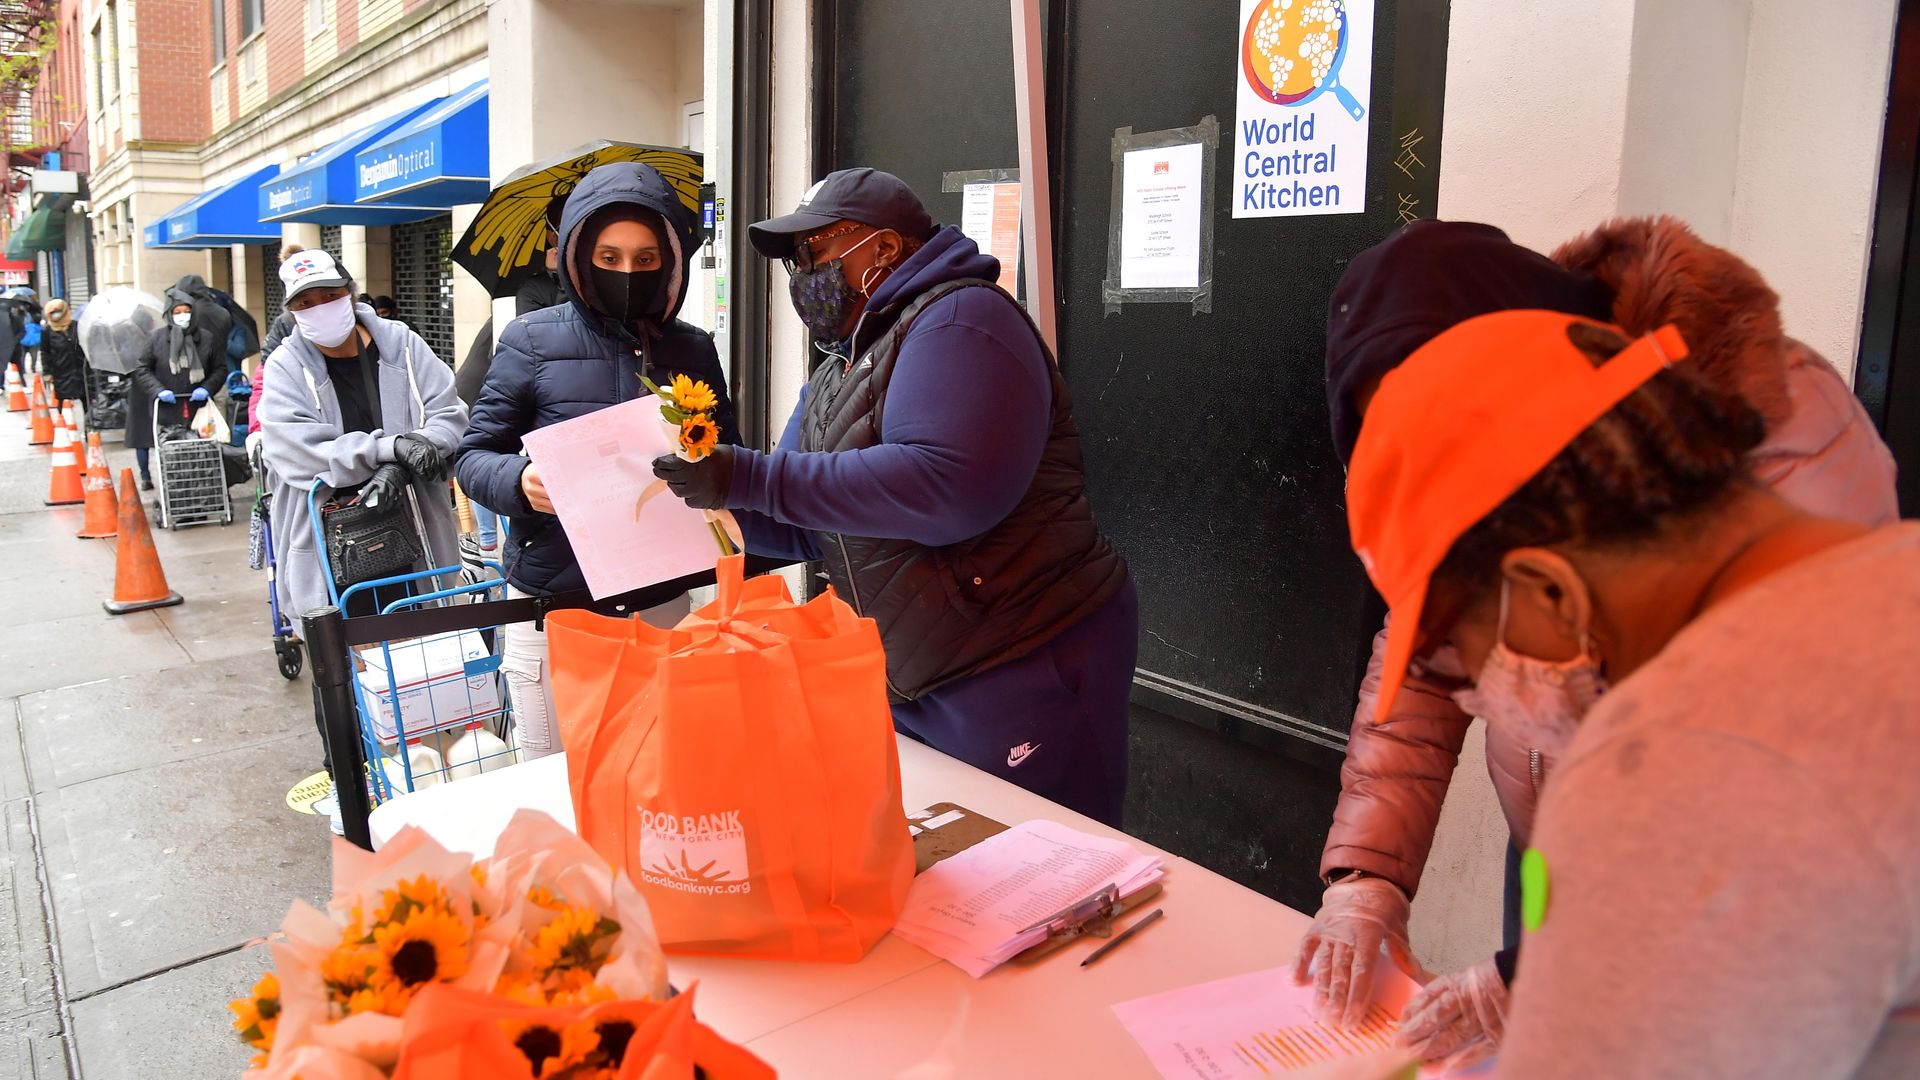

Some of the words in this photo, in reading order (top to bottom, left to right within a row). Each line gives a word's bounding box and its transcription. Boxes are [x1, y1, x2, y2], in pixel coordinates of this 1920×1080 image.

[1242, 112, 1315, 147] World
[360, 153, 398, 190] Benjamin
[398, 141, 435, 180] Optical
[1244, 143, 1336, 179] Central
[1243, 180, 1340, 211] Kitchen
[1010, 742, 1031, 759] NIKE
[656, 832, 676, 841] NEW
[681, 835, 711, 843] YORK
[716, 831, 742, 841] CITY
[682, 810, 744, 835] BANK
